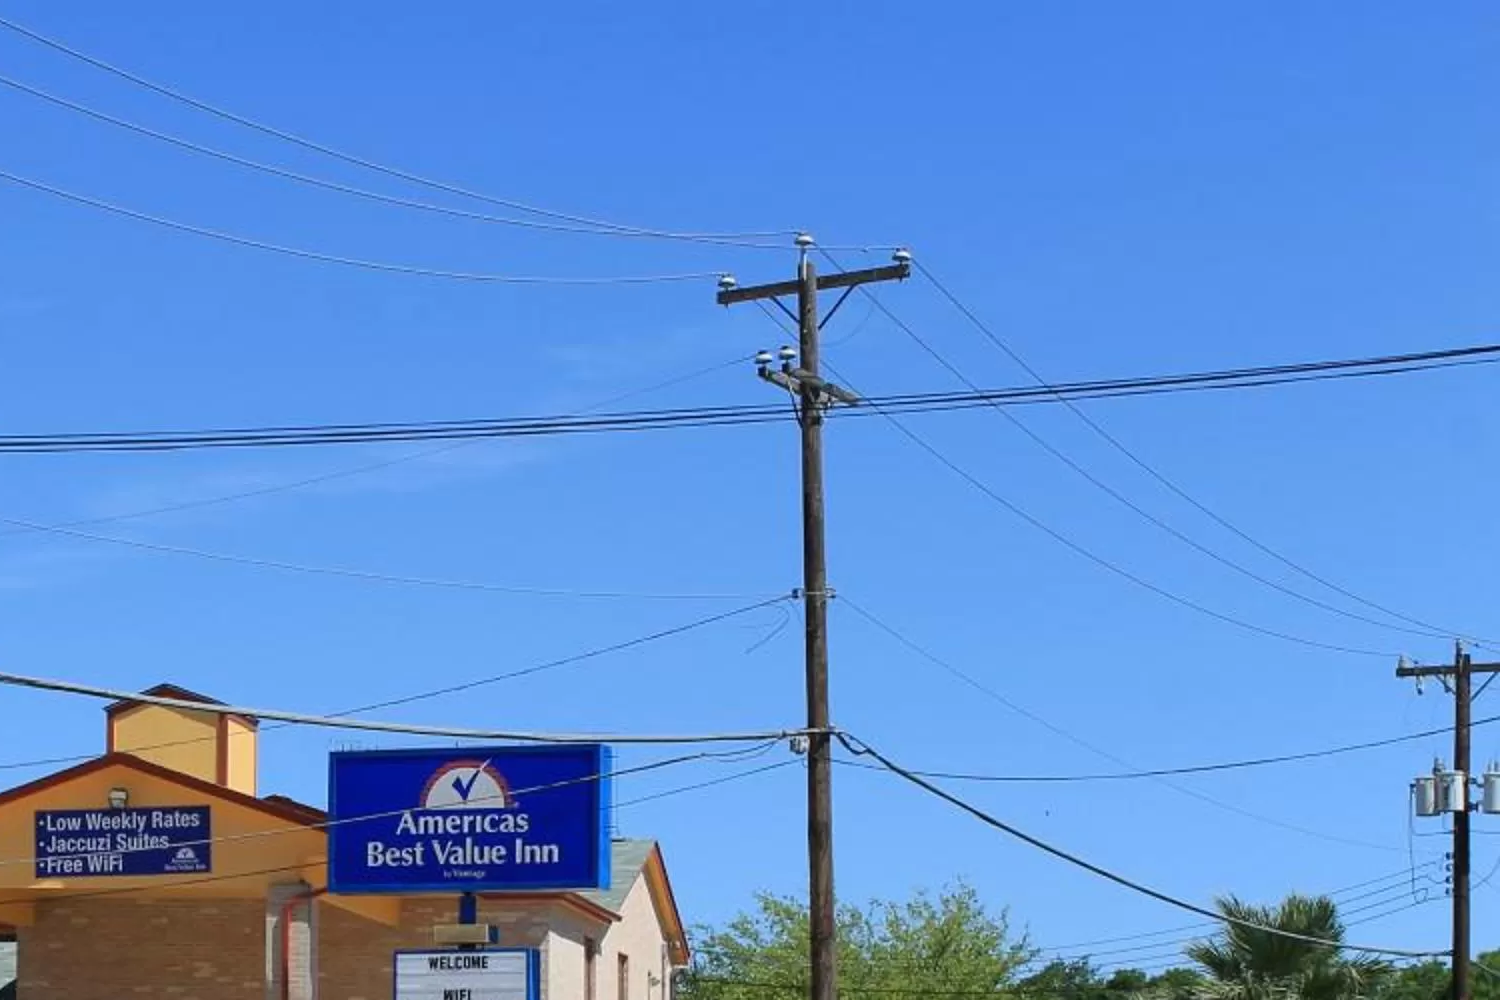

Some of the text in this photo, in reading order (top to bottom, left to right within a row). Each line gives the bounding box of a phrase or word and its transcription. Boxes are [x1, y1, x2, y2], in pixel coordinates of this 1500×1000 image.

[46, 811, 200, 833] Low Weekly Rates
[396, 811, 529, 836] Americas
[46, 833, 169, 853] Jaccuzi Suites
[367, 837, 560, 867] Best Value Inn
[46, 854, 124, 873] Free WiFi
[429, 956, 490, 970] WELCOME
